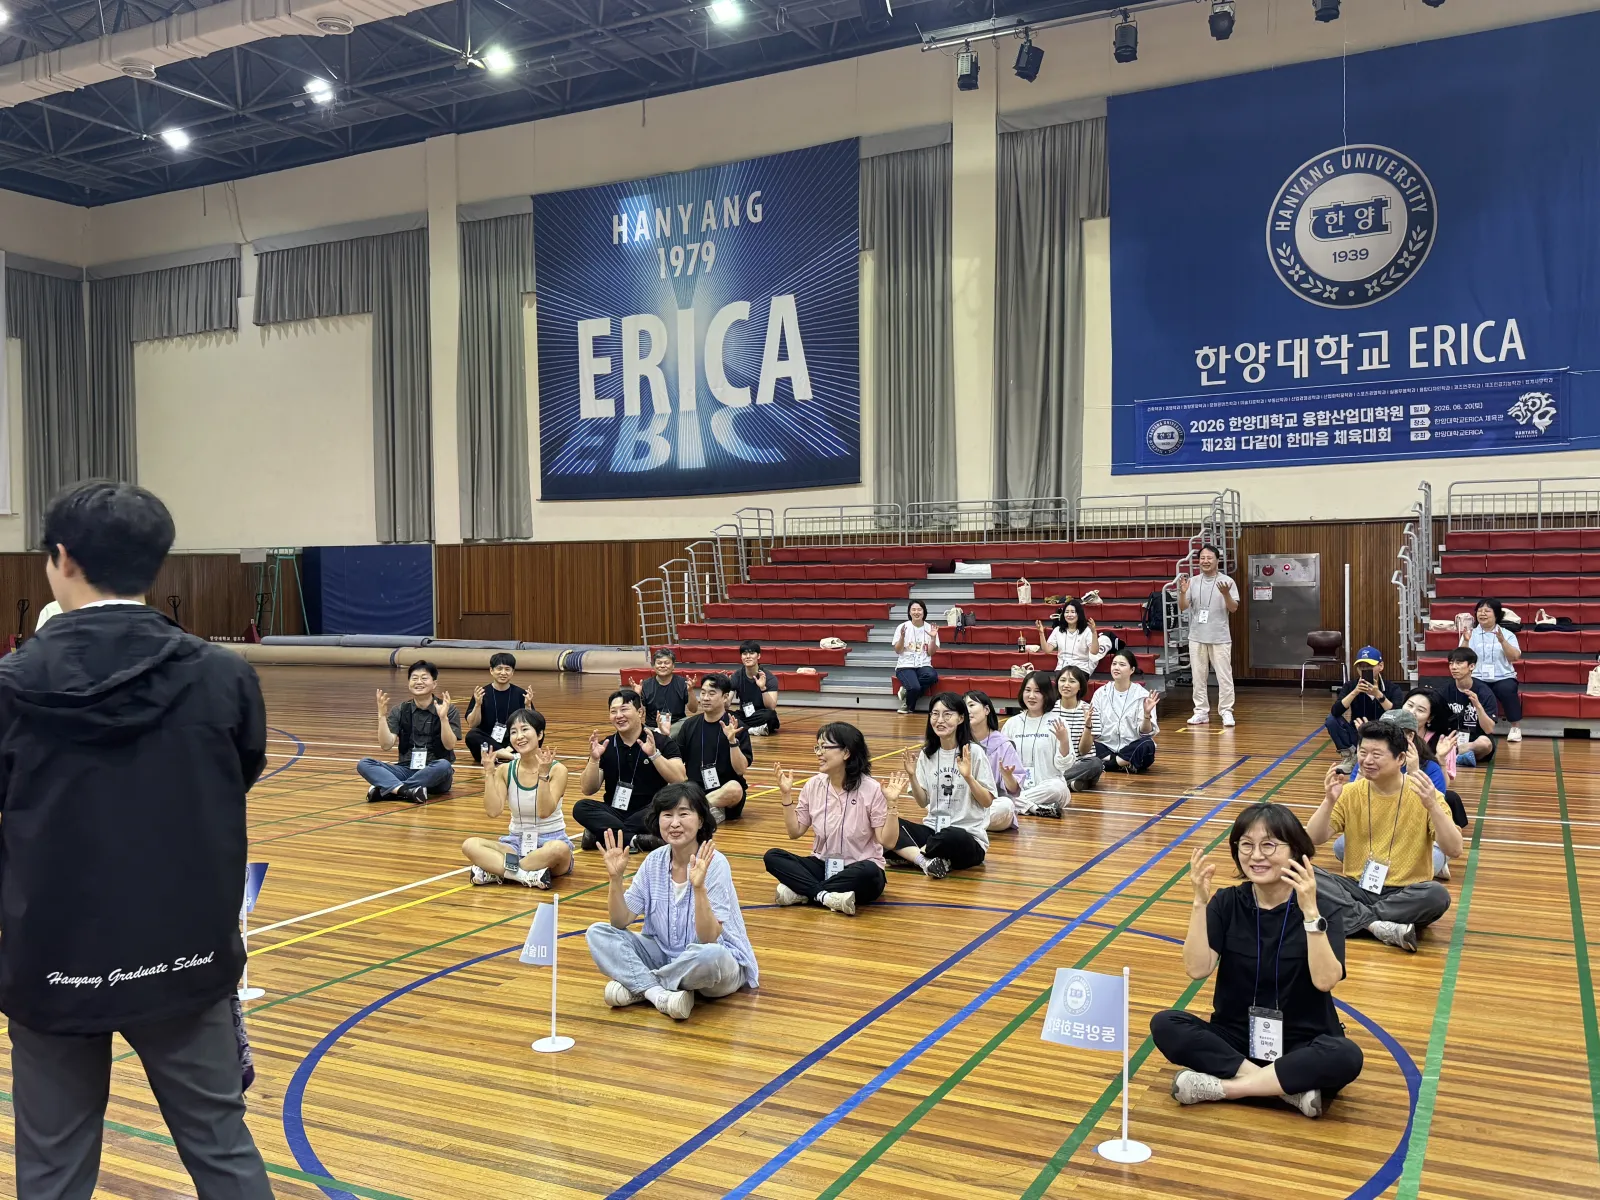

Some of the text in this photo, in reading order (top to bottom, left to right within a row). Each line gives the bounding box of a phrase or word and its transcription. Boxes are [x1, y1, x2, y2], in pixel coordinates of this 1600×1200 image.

[1275, 152, 1428, 231] HANYANG UNIVERSITY
[612, 190, 763, 245] HANYANG
[1324, 206, 1375, 234] 한양
[658, 241, 715, 279] 1979
[1332, 248, 1369, 263] 1939
[577, 294, 813, 420] ERICA
[1194, 318, 1526, 386] 한양대학교 ERICA
[1189, 405, 1404, 433] 2026 한양대학교 융합산업대학원
[1413, 406, 1426, 414] 일시
[1413, 418, 1426, 426] 장소
[1434, 404, 1452, 412] 2026.
[1434, 414, 1504, 425] 한양대학교ERICA 체육관
[1201, 436, 1236, 453] 제2회
[1241, 434, 1282, 451] 다같이
[1286, 431, 1329, 448] 한마음
[1333, 427, 1392, 445] 체육대회
[1434, 429, 1484, 438] 한양대학교ERICA
[47, 951, 215, 988] Hanyang Graduate School
